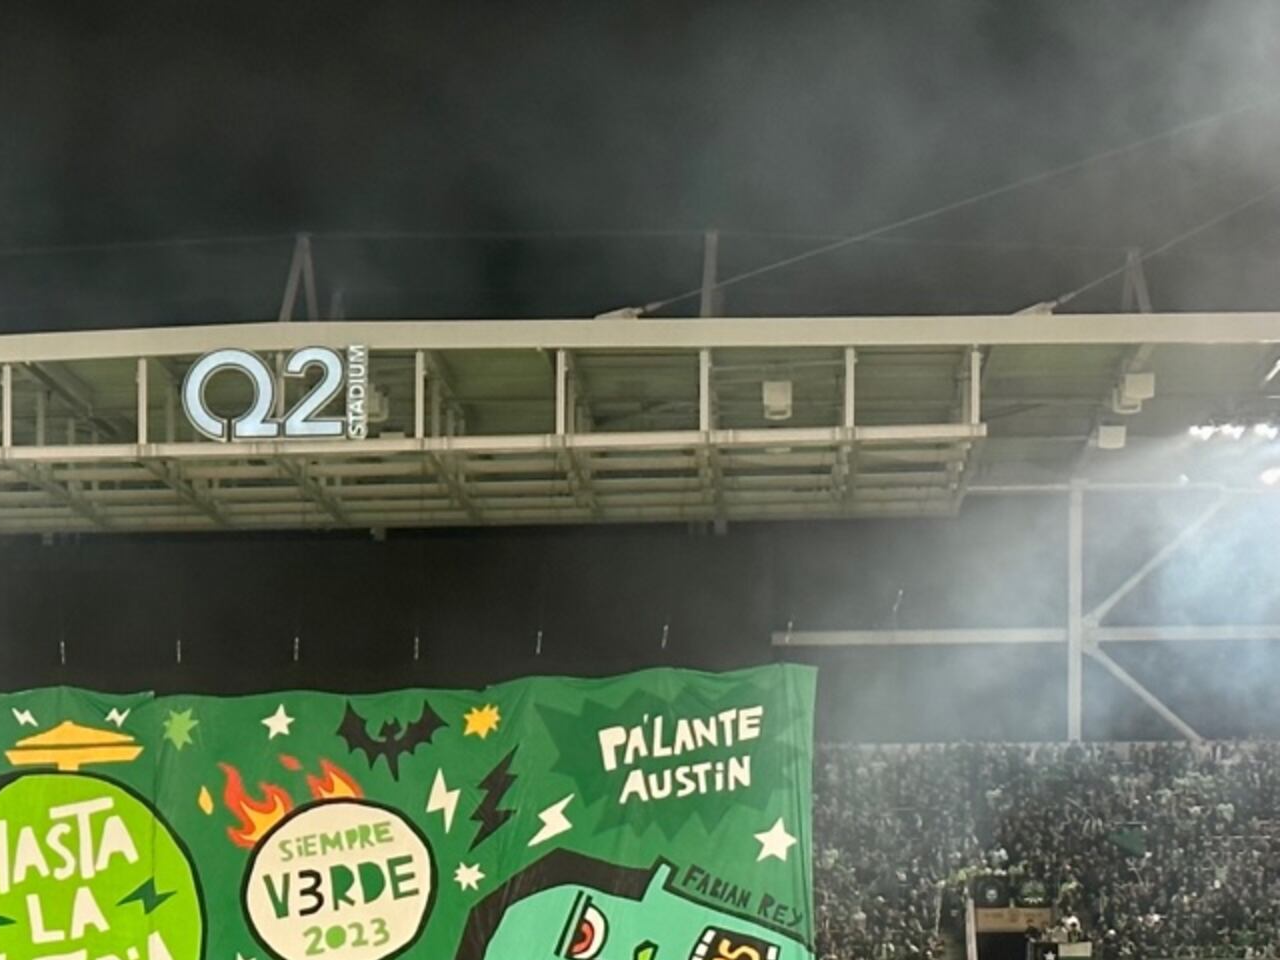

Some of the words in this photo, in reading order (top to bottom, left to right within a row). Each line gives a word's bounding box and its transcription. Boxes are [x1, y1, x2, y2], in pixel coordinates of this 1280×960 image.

[181, 346, 347, 443] Q2
[348, 344, 368, 439] STADIUM
[26, 887, 110, 944] LA
[262, 854, 420, 919] V3RDE
[682, 864, 752, 908] FABIAN
[302, 917, 391, 956] 2023
